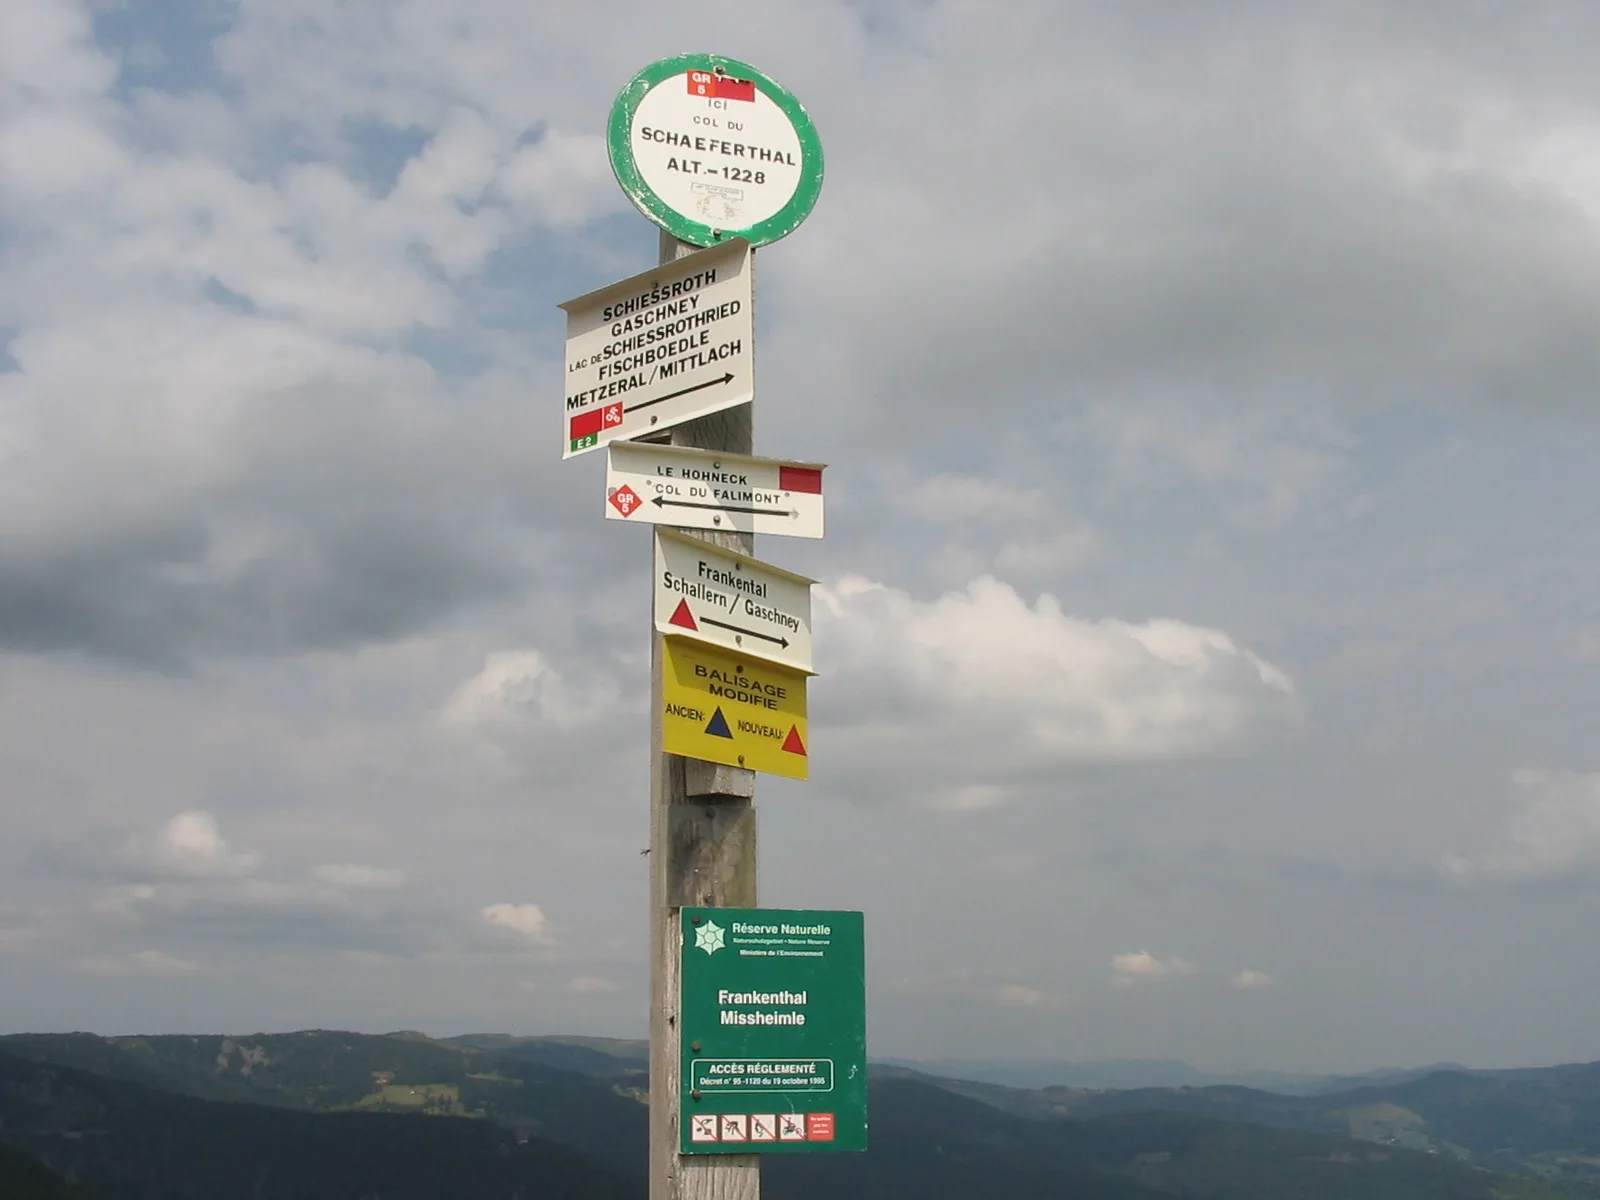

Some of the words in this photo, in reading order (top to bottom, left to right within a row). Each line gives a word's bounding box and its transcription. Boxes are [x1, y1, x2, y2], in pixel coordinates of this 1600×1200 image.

[692, 73, 711, 84] GR
[697, 85, 706, 95] 5
[708, 98, 728, 110] ICI
[693, 116, 719, 127] COL
[727, 121, 743, 131] DU
[641, 127, 796, 166] SCHAEFERTHAL
[603, 269, 716, 322] SCHIESSROTH
[611, 294, 699, 337] GASCHNEY
[569, 359, 588, 372] LAC
[590, 352, 602, 364] DE
[603, 300, 741, 360] SCHIESSROTHRIED
[598, 330, 710, 381] FISCHBOEDLE
[657, 465, 673, 477] LE
[682, 469, 747, 486] HOHNECK
[617, 493, 634, 504] GR
[655, 483, 681, 496] COL
[689, 487, 707, 498] DU
[713, 488, 781, 504] FALIMONT
[621, 503, 630, 513] 5
[699, 561, 767, 598] Frankental
[695, 664, 787, 699] BALISAGE
[709, 684, 778, 711] MODIFIE
[732, 922, 778, 934] Réserve
[781, 924, 831, 935] Naturelle
[719, 989, 807, 1005] Frankenthal
[720, 1010, 805, 1026] Missheimle
[709, 1062, 745, 1074] ACCÈS
[747, 1062, 817, 1074] RÉGLEMENTÉ
[762, 1077, 772, 1085] du
[782, 1077, 808, 1085] octobre
